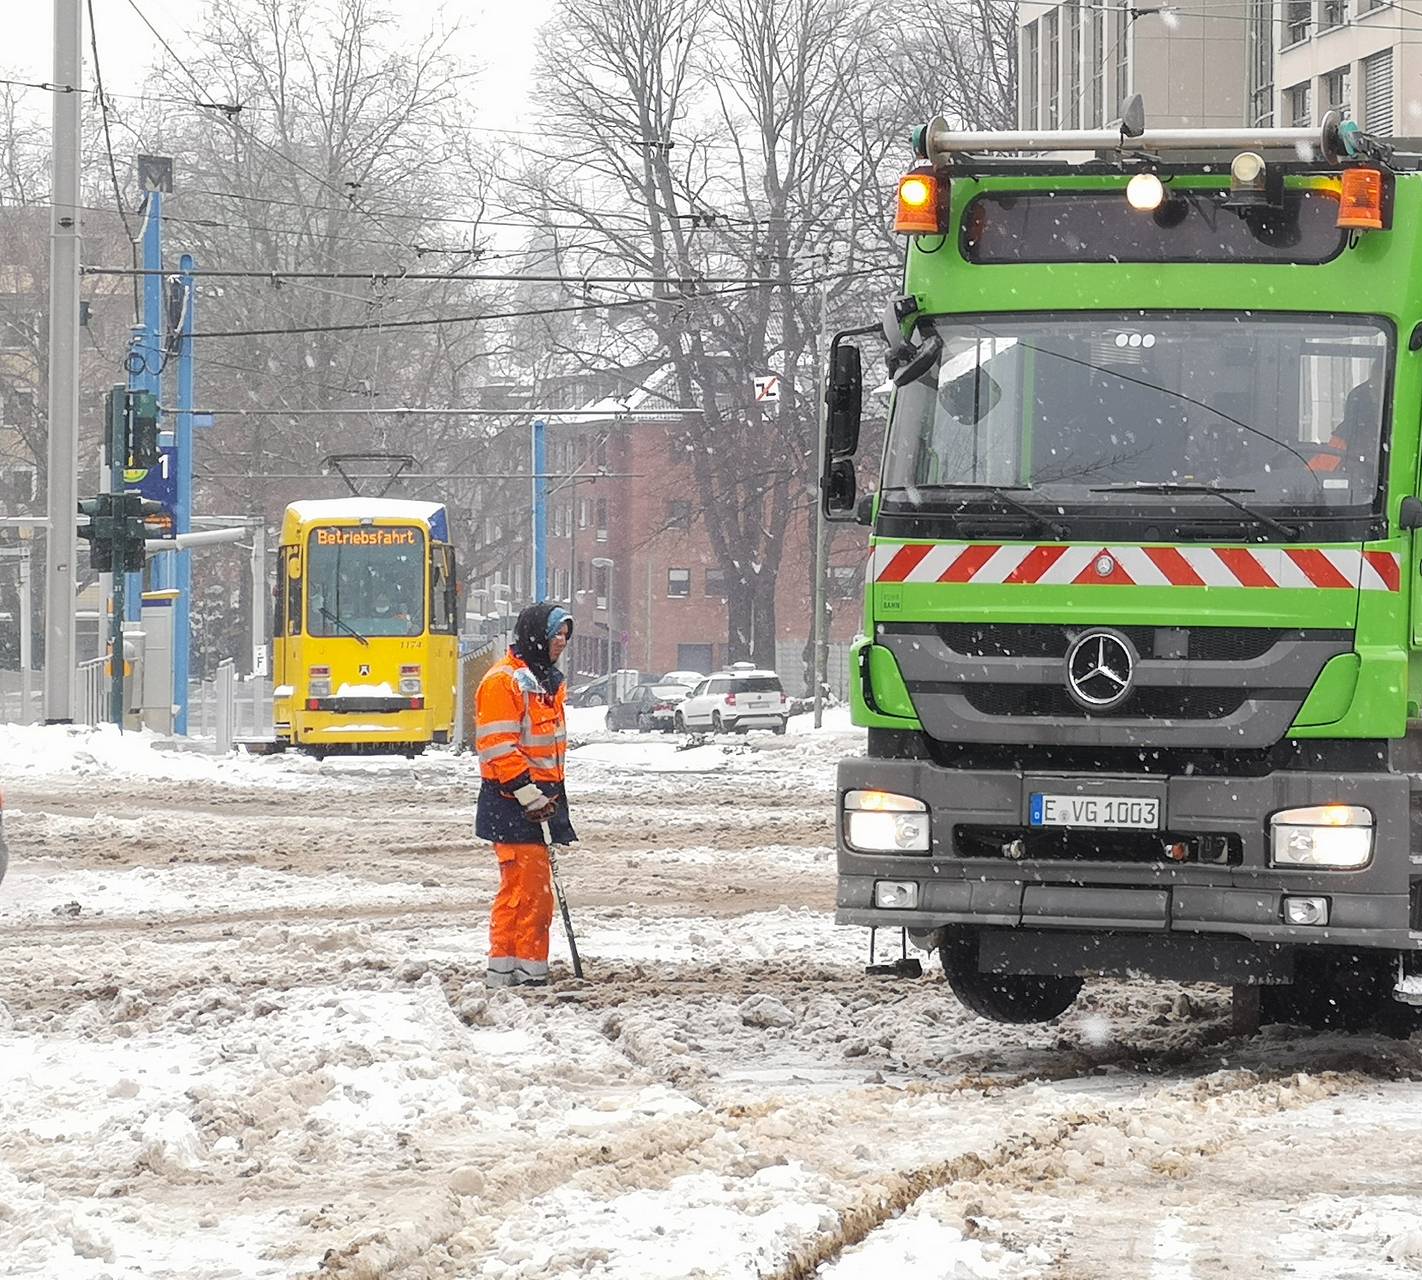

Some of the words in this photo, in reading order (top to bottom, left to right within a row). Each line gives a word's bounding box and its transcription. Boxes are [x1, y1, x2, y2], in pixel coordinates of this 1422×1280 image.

[317, 530, 415, 545] Betriebsfahrt
[1045, 800, 1056, 821] E
[1072, 800, 1097, 822] VG
[1104, 801, 1156, 824] 1003
